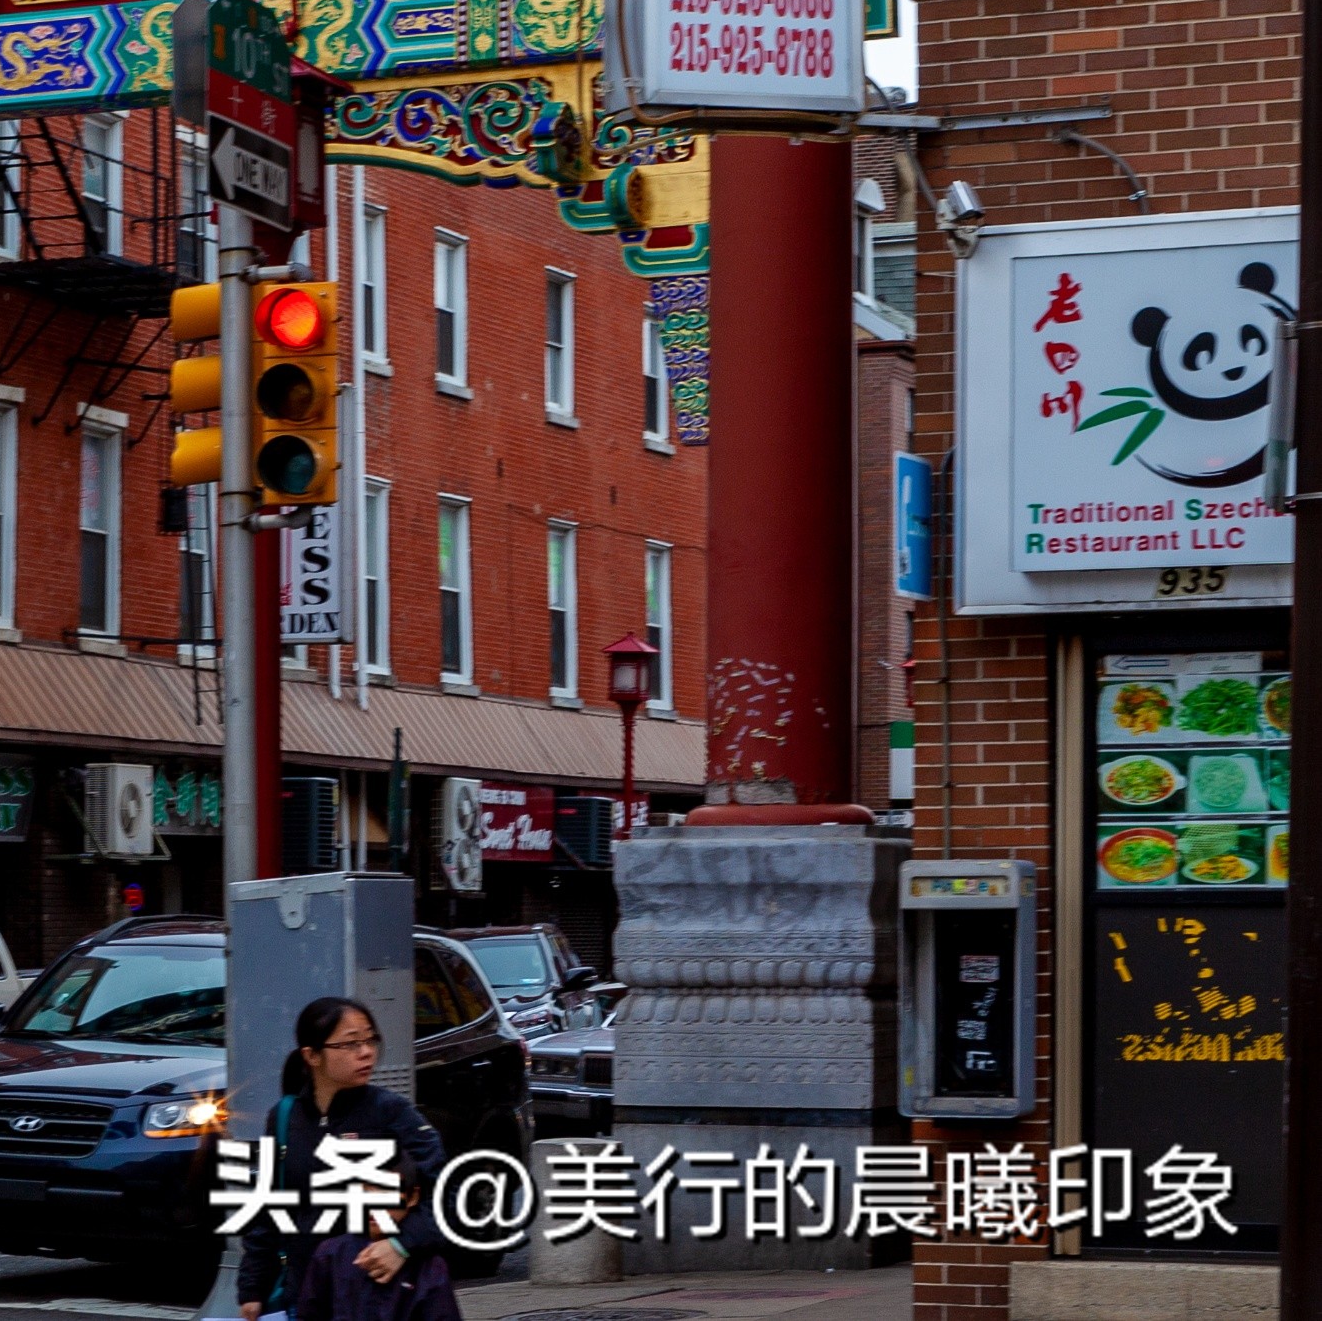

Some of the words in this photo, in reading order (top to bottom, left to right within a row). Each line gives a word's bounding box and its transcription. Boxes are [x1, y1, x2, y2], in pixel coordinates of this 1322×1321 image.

[669, 22, 835, 79] 215-925-8788
[1033, 272, 1084, 435] 老四川
[1027, 500, 1175, 525] Traditional
[1185, 497, 1296, 521] Szech
[1026, 531, 1181, 554] Restaurant
[1190, 527, 1246, 551] LLC
[1158, 567, 1226, 597] 935
